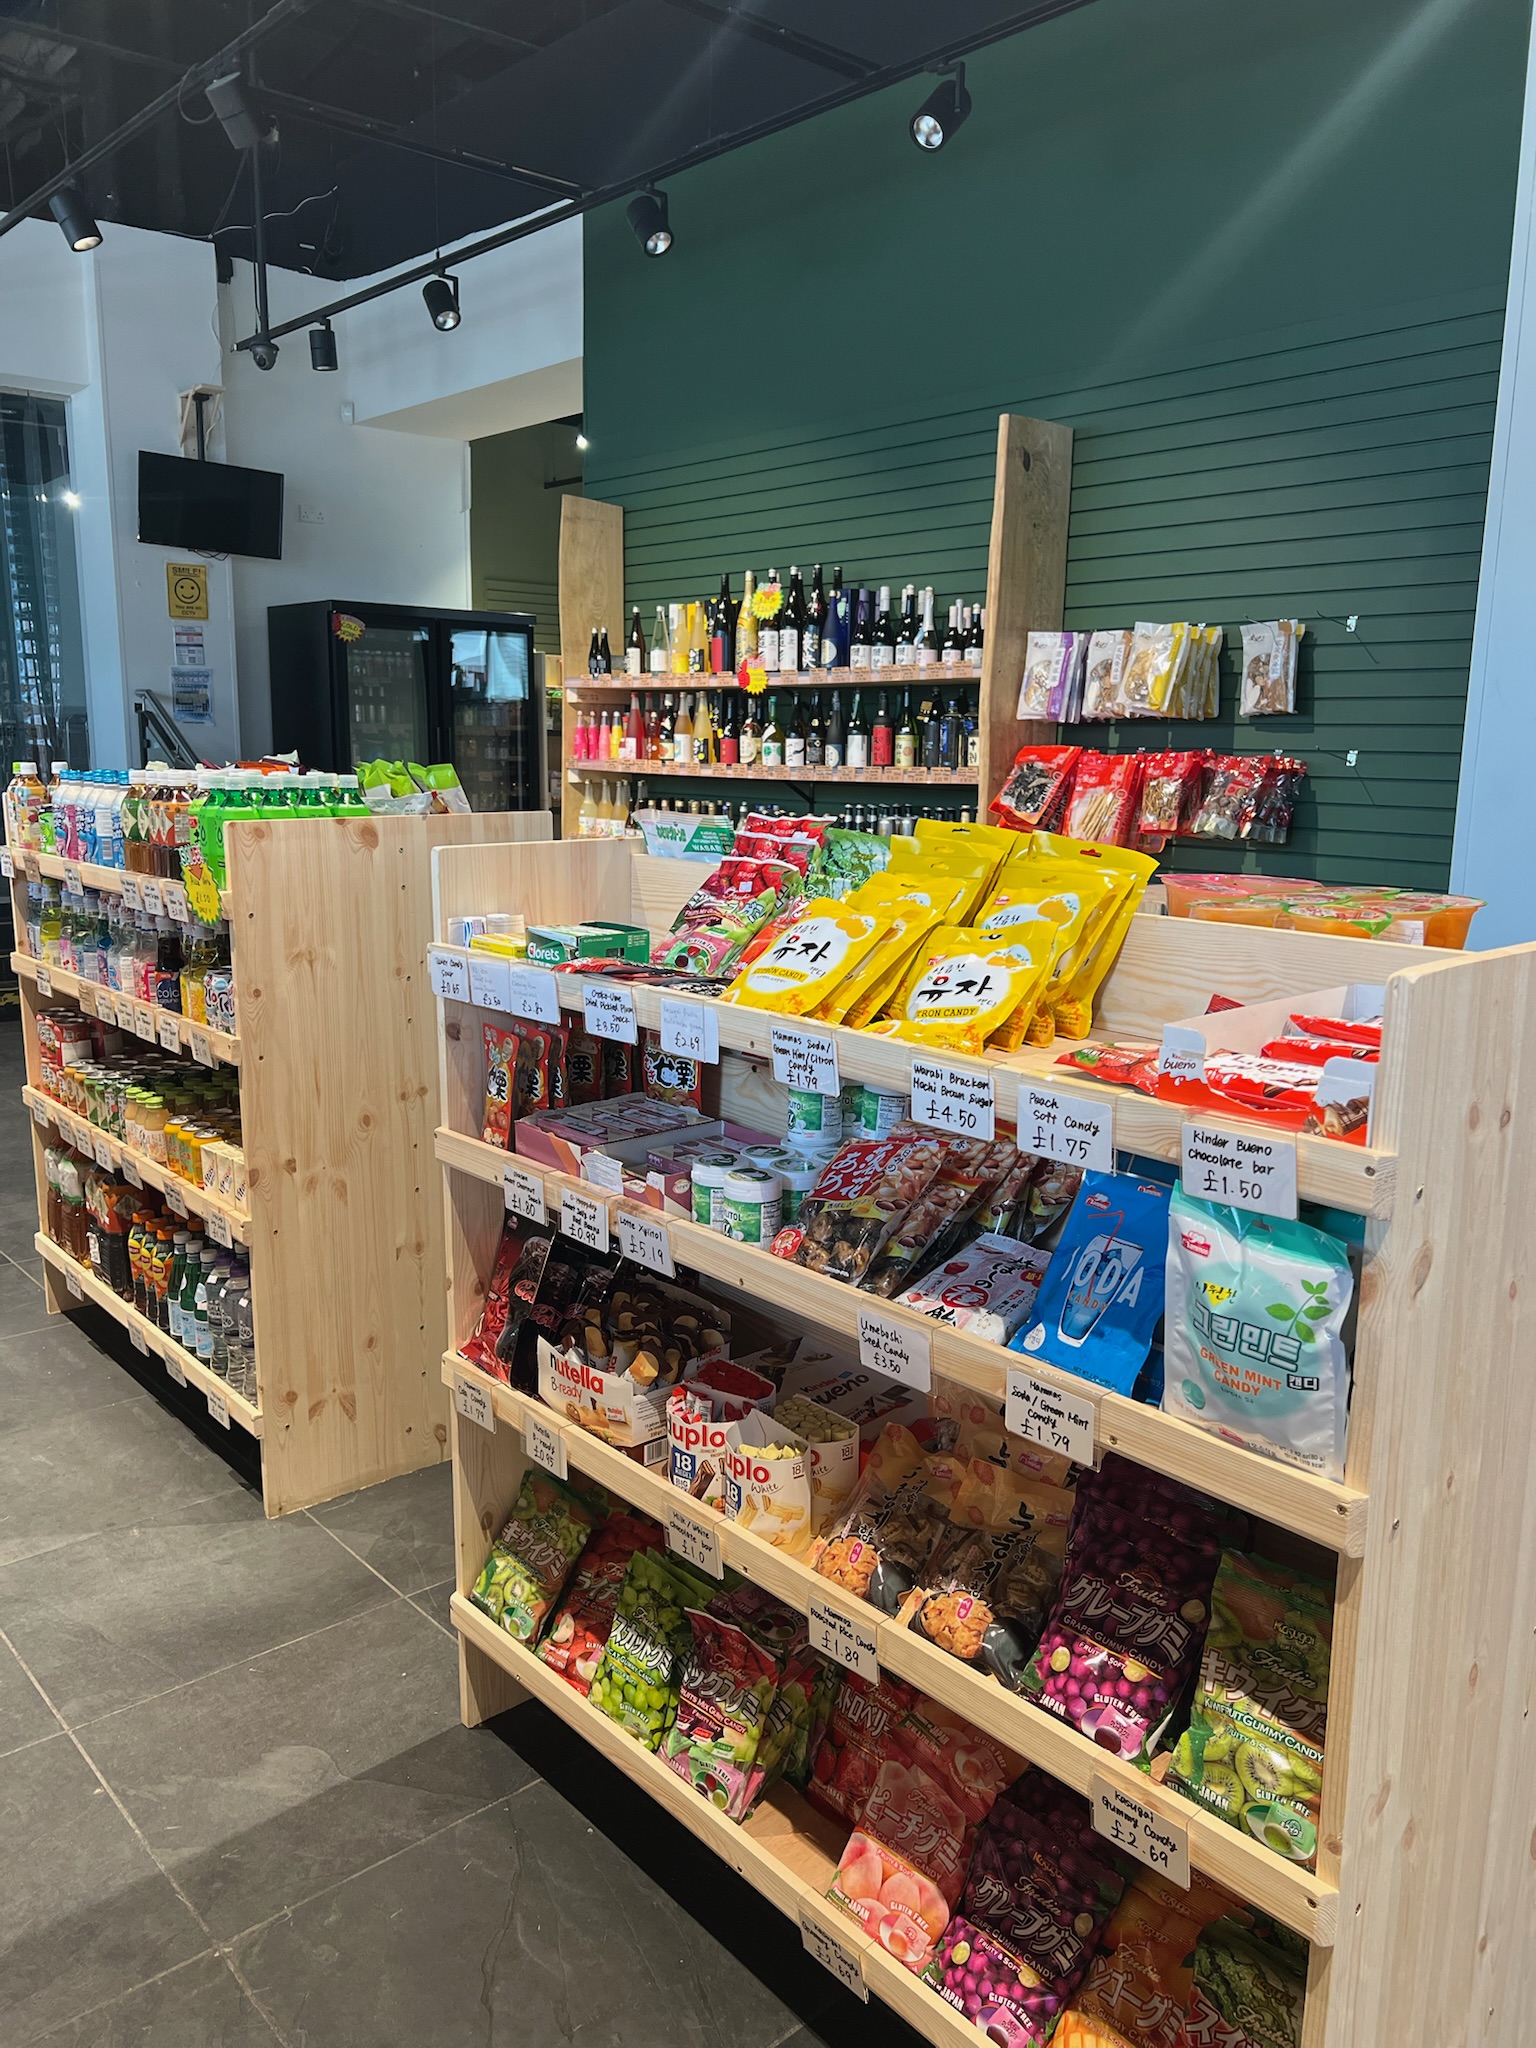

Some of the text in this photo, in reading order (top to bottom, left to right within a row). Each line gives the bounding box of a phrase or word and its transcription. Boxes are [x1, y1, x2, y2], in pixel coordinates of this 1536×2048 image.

[528, 942, 560, 962] Clorets
[772, 934, 831, 963] 유자
[778, 969, 805, 980] CANDY
[917, 975, 993, 1005] 유자
[943, 1006, 976, 1017] CANDY
[674, 1031, 700, 1051] £2.69
[788, 1059, 815, 1075] Candy
[913, 1064, 943, 1081] Warabi
[1163, 1059, 1196, 1071] bueno
[786, 1072, 818, 1089] £1.79
[913, 1077, 937, 1095] Mochi
[941, 1085, 965, 1101] Brown
[926, 1100, 977, 1129] £4.50
[1029, 1092, 1059, 1109] Peach
[1064, 1116, 1100, 1137] Candy
[1032, 1126, 1091, 1160] £1.75
[1193, 1129, 1272, 1157] Kinder Bueno
[1253, 1160, 1275, 1175] bar
[1203, 1169, 1262, 1200] £1.50
[511, 1194, 535, 1217] £1.80
[568, 1223, 596, 1246] £0.99
[620, 1216, 636, 1229] Lotte
[629, 1235, 664, 1265] £5.19
[1069, 1291, 1109, 1314] CANDY
[860, 1317, 903, 1344] Umeboshi
[1193, 1300, 1303, 1373] 그린민트
[861, 1332, 910, 1364] Seed Candy
[550, 1352, 604, 1395] nutella
[873, 1353, 901, 1374] £3.50
[1200, 1346, 1282, 1391] GREEN MINT
[551, 1377, 583, 1403] B-ready
[1214, 1370, 1261, 1397] CANDY
[1288, 1375, 1319, 1391] 캔디
[463, 1399, 485, 1423] £1.79
[1040, 1401, 1065, 1419] Green
[1067, 1410, 1089, 1431] Mint
[1021, 1419, 1070, 1452] £1.79
[675, 1452, 692, 1471] 18
[675, 1477, 689, 1488] BIG
[726, 1484, 739, 1502] 18
[751, 1481, 784, 1495] White
[501, 1518, 569, 1581] キウイグミ
[1115, 1572, 1168, 1607] Frutia
[1063, 1573, 1193, 1669] グレープグミ
[1273, 1619, 1316, 1646] Kasugai
[821, 1630, 859, 1667] £1.89
[839, 1624, 854, 1641] Rice
[856, 1636, 877, 1656] Candy
[1063, 1614, 1164, 1672] GRAPE GUMMY CANDY
[620, 1655, 656, 1686] GUMMY CANDY
[710, 1653, 748, 1683] Frutia
[1108, 1657, 1127, 1671] SOFT
[1248, 1650, 1318, 1690] Frutia
[636, 1711, 650, 1724] FREE
[697, 1697, 709, 1710] MIX
[724, 1715, 747, 1735] CANDY
[1040, 1693, 1067, 1717] JAPAN
[1094, 1694, 1145, 1725] GLUTEN FREE
[1204, 1697, 1325, 1763] KIWIFRUIT GUMMY CANDY
[699, 1760, 731, 1783] GLUTEN FREE
[907, 1789, 943, 1818] Frutia
[1114, 1790, 1154, 1822] Kasugai
[1199, 1785, 1229, 1811] JAPAN
[1256, 1788, 1311, 1818] GLUTEN FREE
[864, 1778, 963, 1876] ピーチグミ
[1101, 1796, 1178, 1853] Gummy Candy
[864, 1822, 943, 1883] PEACH GUMMY CANDY
[1110, 1819, 1169, 1868] £2.69
[848, 1899, 870, 1921] JAPAN
[1013, 1876, 1063, 1916] Frutia
[890, 1902, 930, 1932] GLUTEN FREE
[973, 1874, 1085, 1977] グレープグミ
[970, 1914, 1056, 1981] GRAPE GUMMY CANDY
[977, 1937, 999, 1956] FRUITY
[1003, 1957, 1022, 1974] SOFT
[815, 1945, 852, 1985] £2.69
[1115, 1942, 1162, 1984] Frutia
[939, 1986, 965, 2011] JAPAN
[988, 1992, 1034, 2030] GLUTEN FREE
[1097, 2007, 1127, 2032] GUMMY
